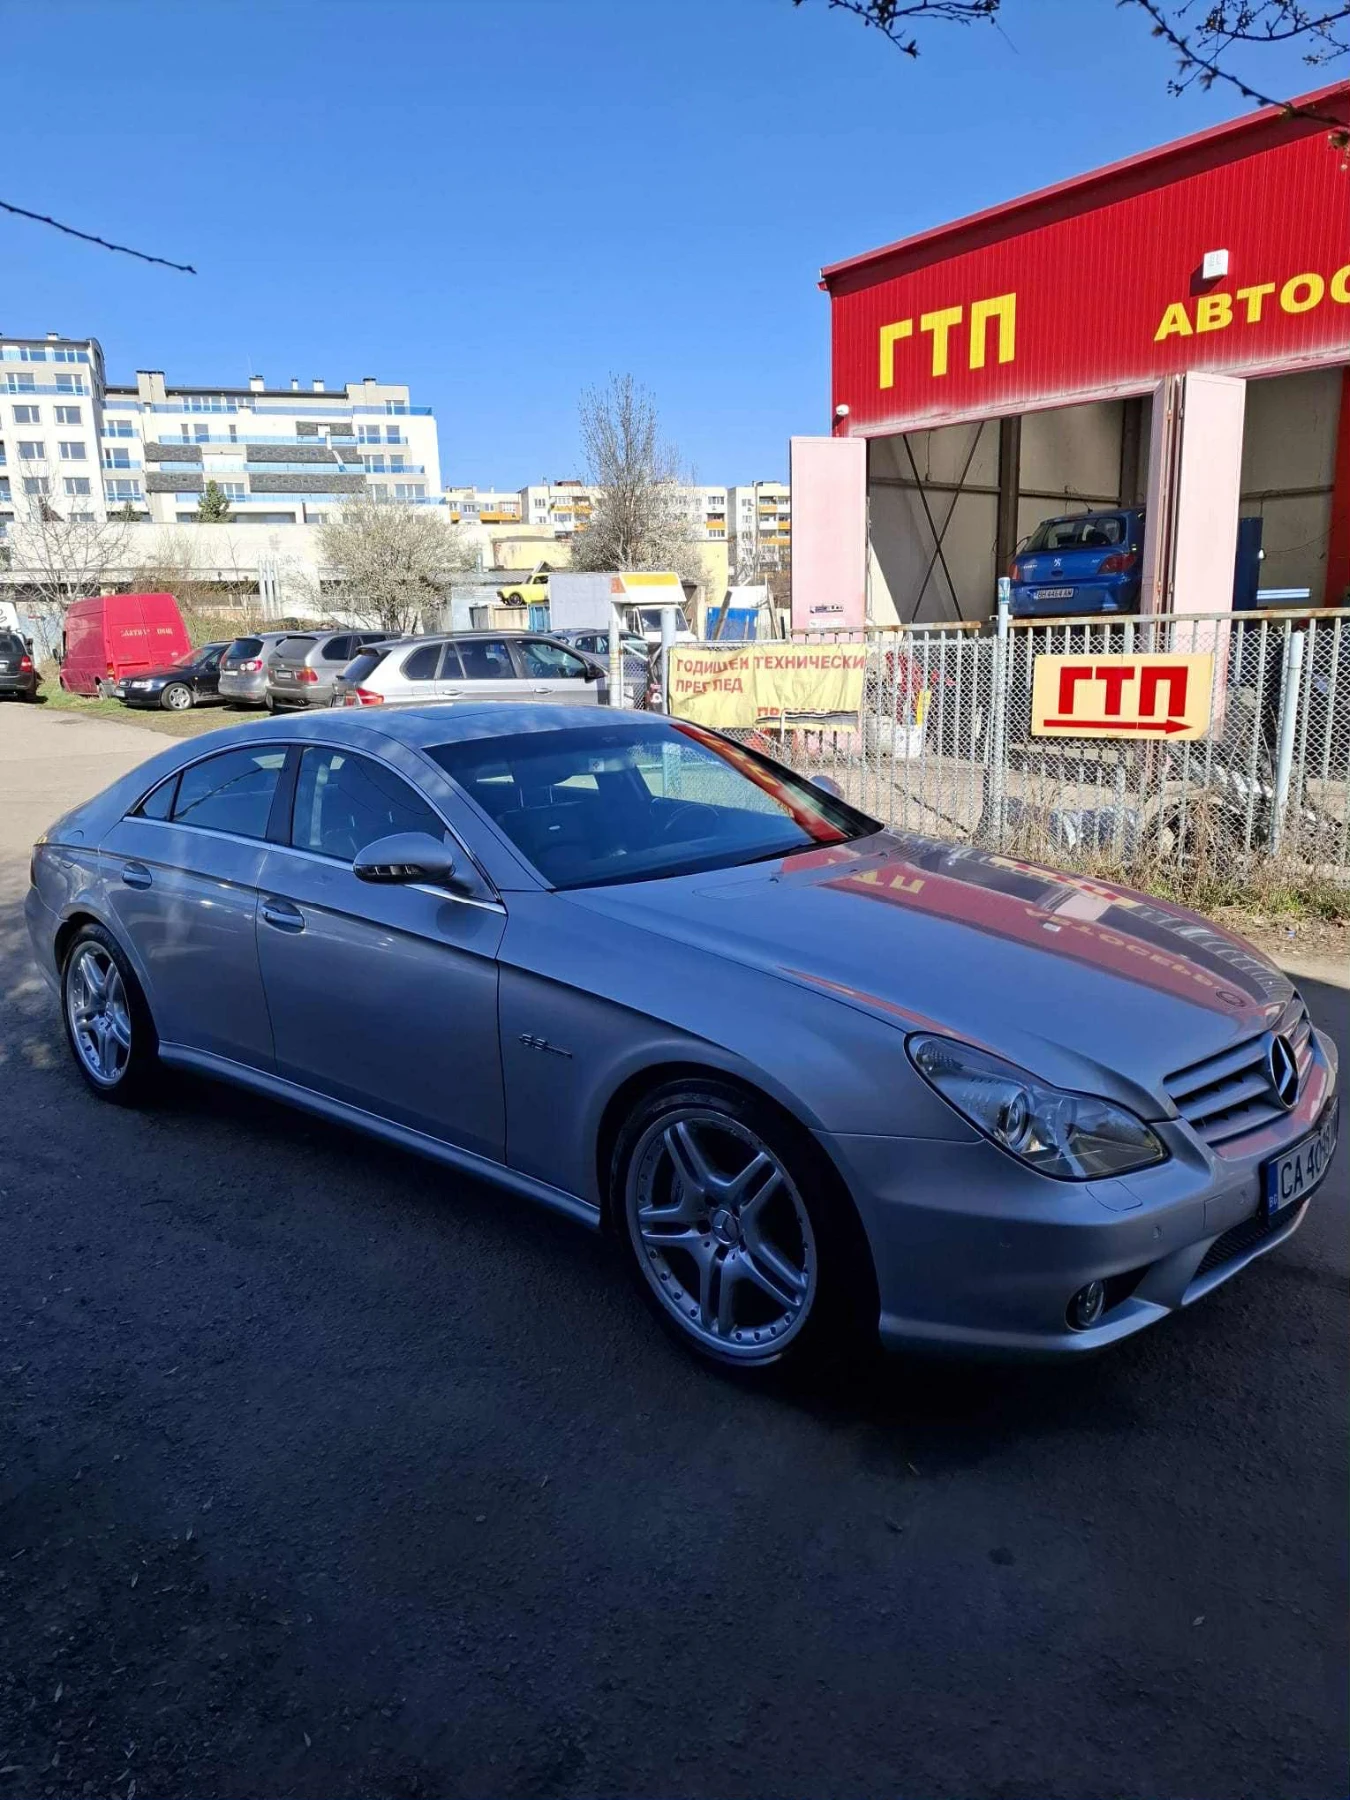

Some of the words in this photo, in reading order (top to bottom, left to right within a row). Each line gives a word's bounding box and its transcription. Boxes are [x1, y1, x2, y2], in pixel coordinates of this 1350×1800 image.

[880, 292, 1017, 389] ГТП
[676, 657, 749, 675] ГОДИШЕН
[754, 655, 866, 670] ТЕХНИЧЕСКИ
[1058, 666, 1188, 717] ГТП
[1281, 1155, 1304, 1199] CA
[1268, 1193, 1278, 1209] BG
